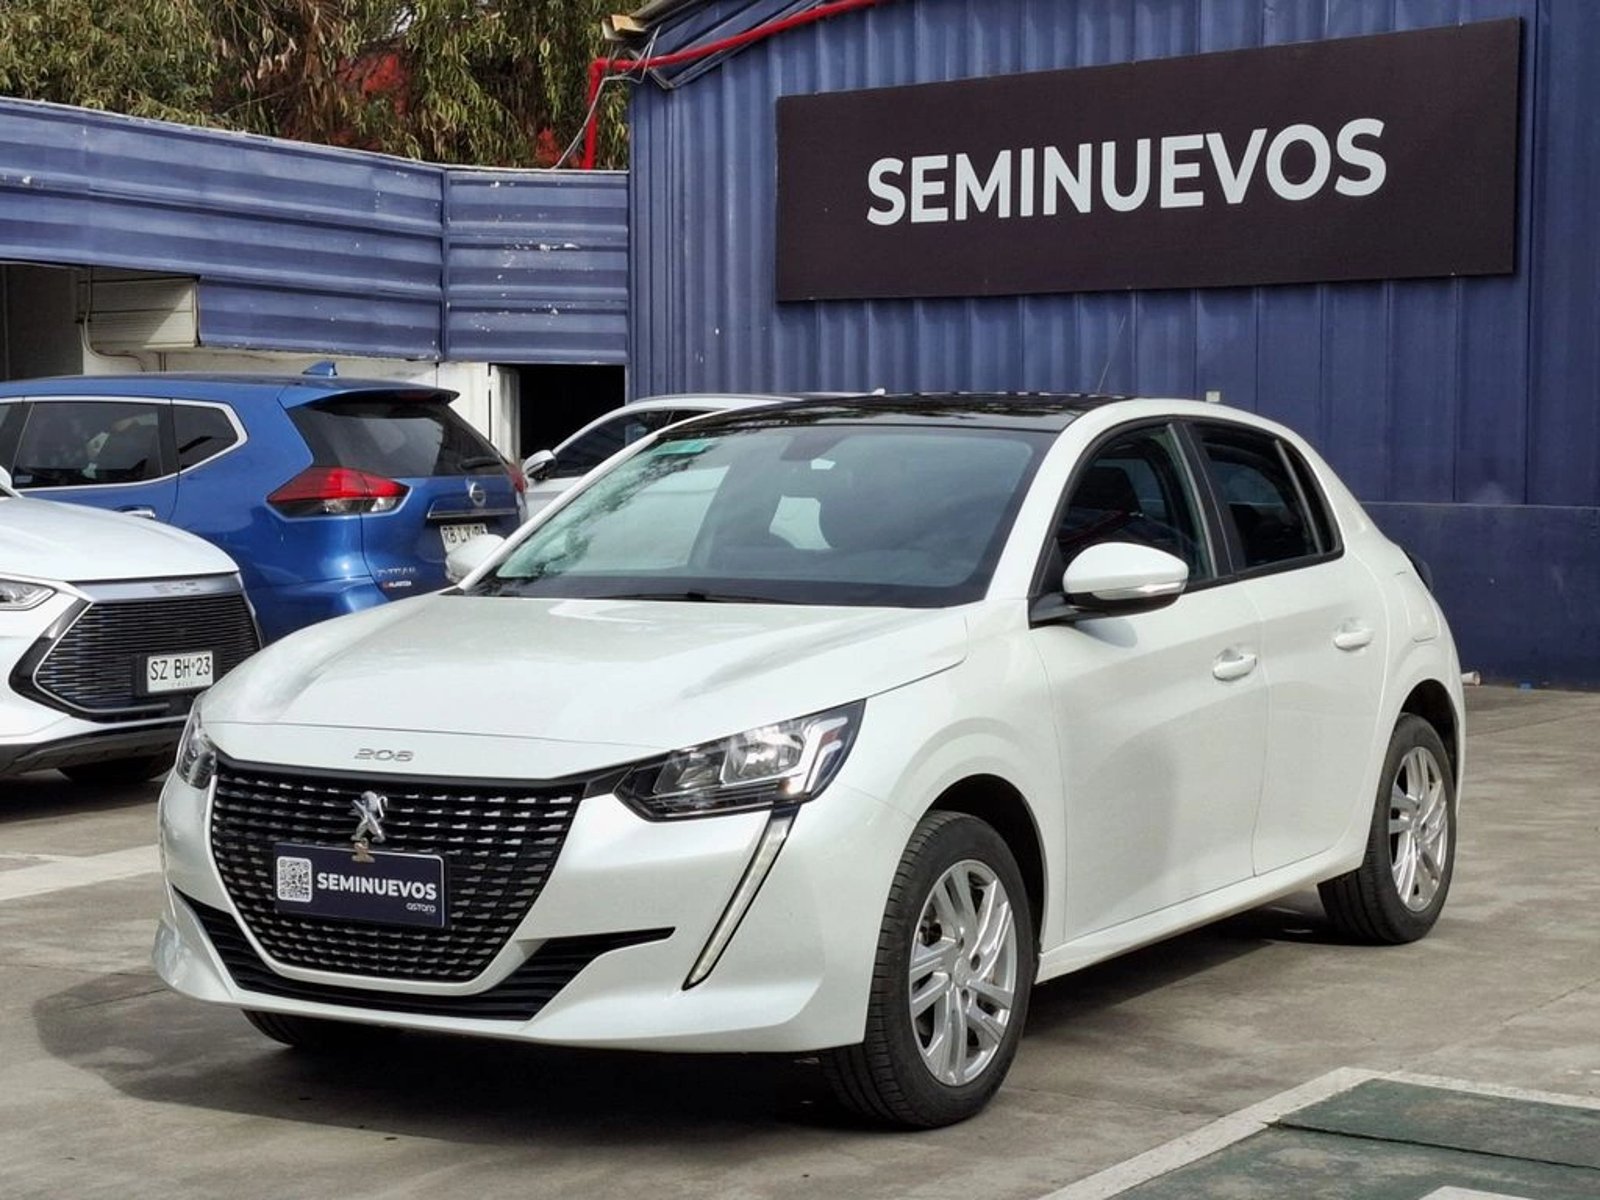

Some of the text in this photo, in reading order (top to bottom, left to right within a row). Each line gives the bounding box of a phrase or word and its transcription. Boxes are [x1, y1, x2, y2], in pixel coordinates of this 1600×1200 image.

[866, 118, 1387, 226] SEMINUEVOS
[150, 660, 168, 681] SZ
[317, 872, 437, 901] SEMINUEVOS
